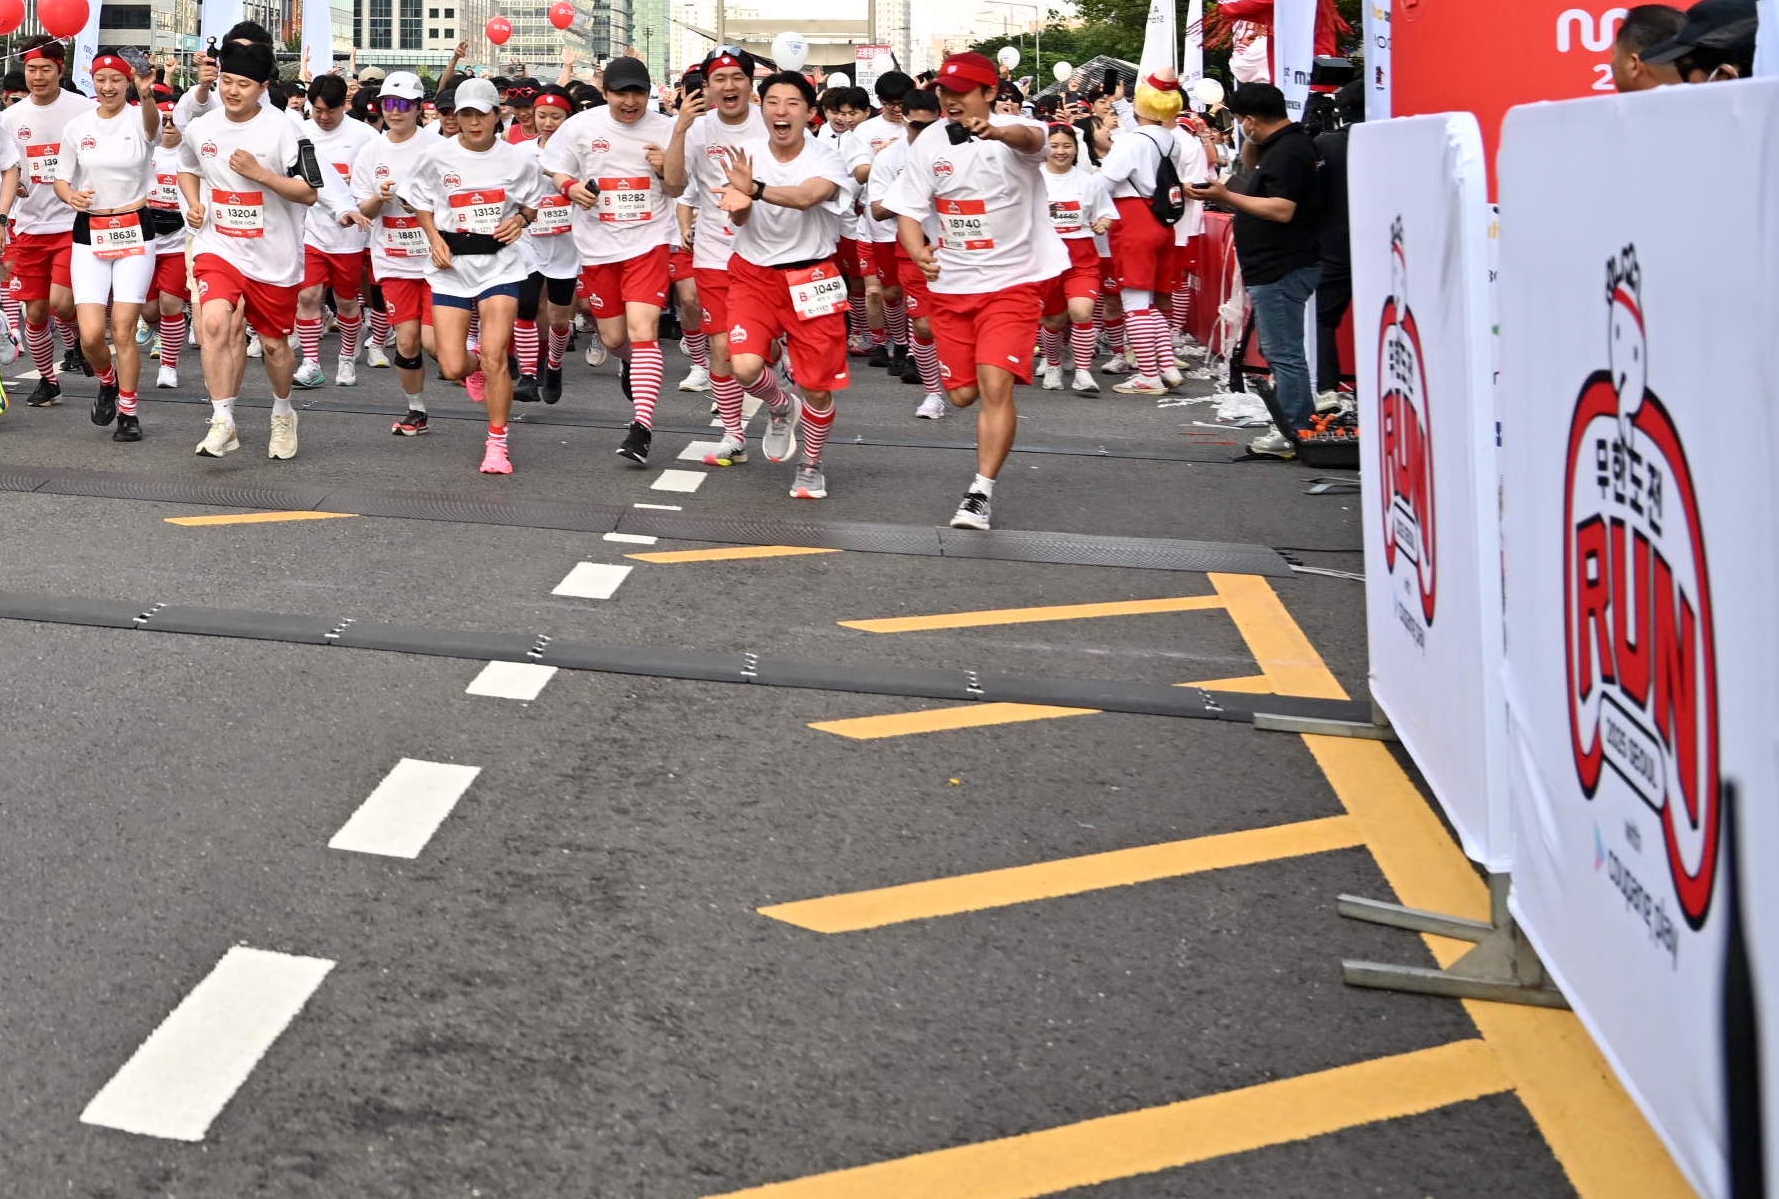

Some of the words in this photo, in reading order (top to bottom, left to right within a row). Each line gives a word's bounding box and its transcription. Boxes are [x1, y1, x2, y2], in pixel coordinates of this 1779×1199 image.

[33, 162, 39, 170] B
[216, 210, 222, 218] B
[228, 208, 257, 218] 13204
[459, 214, 466, 222] B
[473, 207, 501, 217] 13132
[543, 209, 568, 218] 18329
[949, 219, 980, 229] 18740
[97, 235, 104, 244] B
[109, 230, 137, 240] 18636
[1382, 387, 1431, 568] RUN
[1596, 438, 1662, 538] 무한도전
[1576, 512, 1699, 833] RUN
